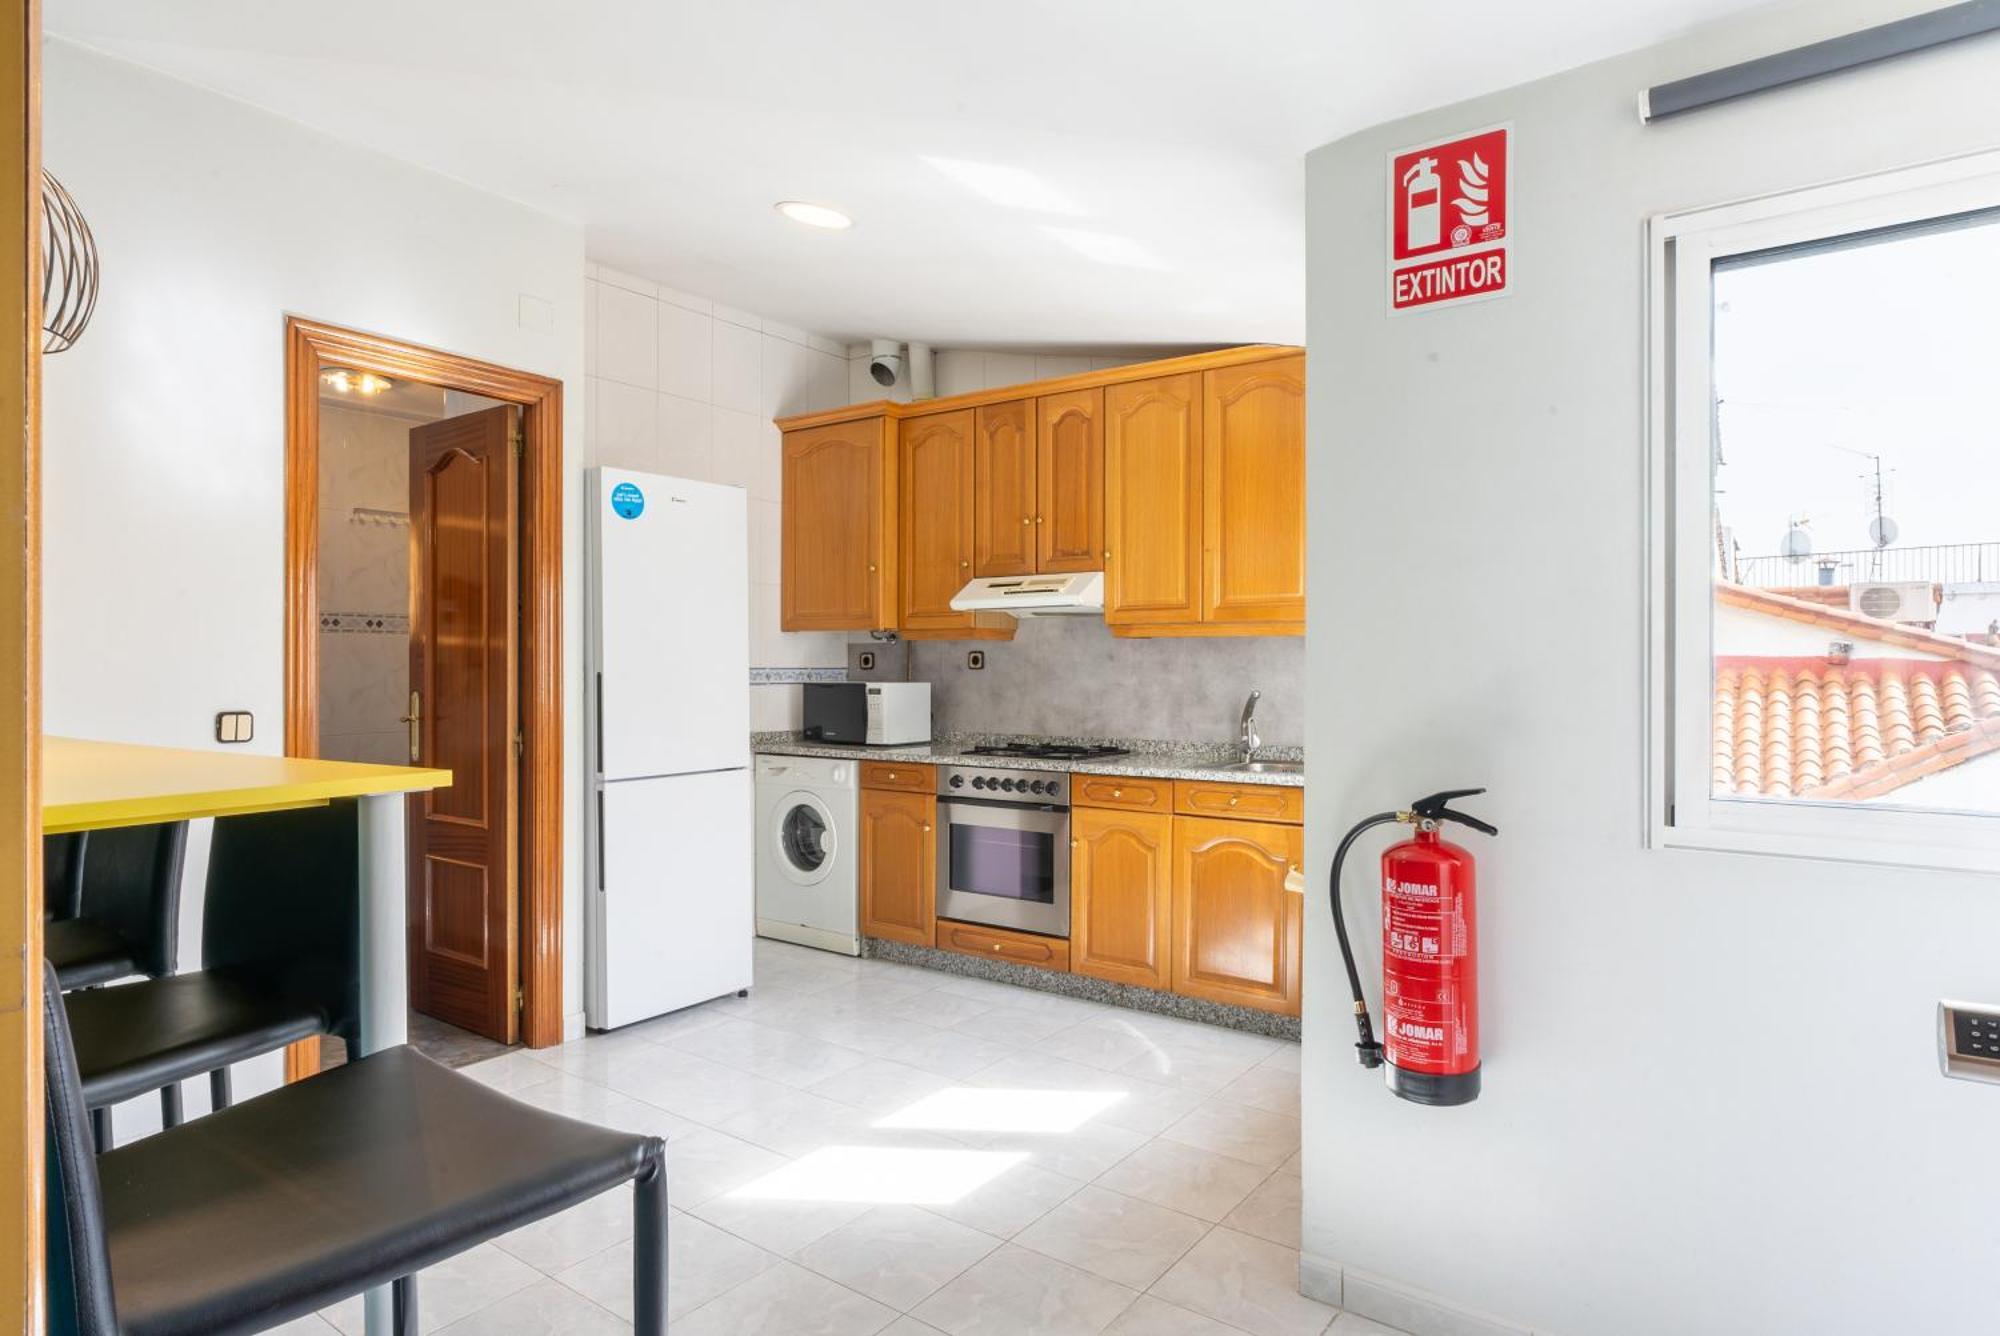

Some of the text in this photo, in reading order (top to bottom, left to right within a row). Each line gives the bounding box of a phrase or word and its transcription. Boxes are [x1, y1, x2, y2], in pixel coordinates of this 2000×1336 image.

[1395, 255, 1503, 302] EXTINTOR
[1397, 881, 1438, 897] JOMAR
[1398, 1022, 1444, 1041] JOMAR
